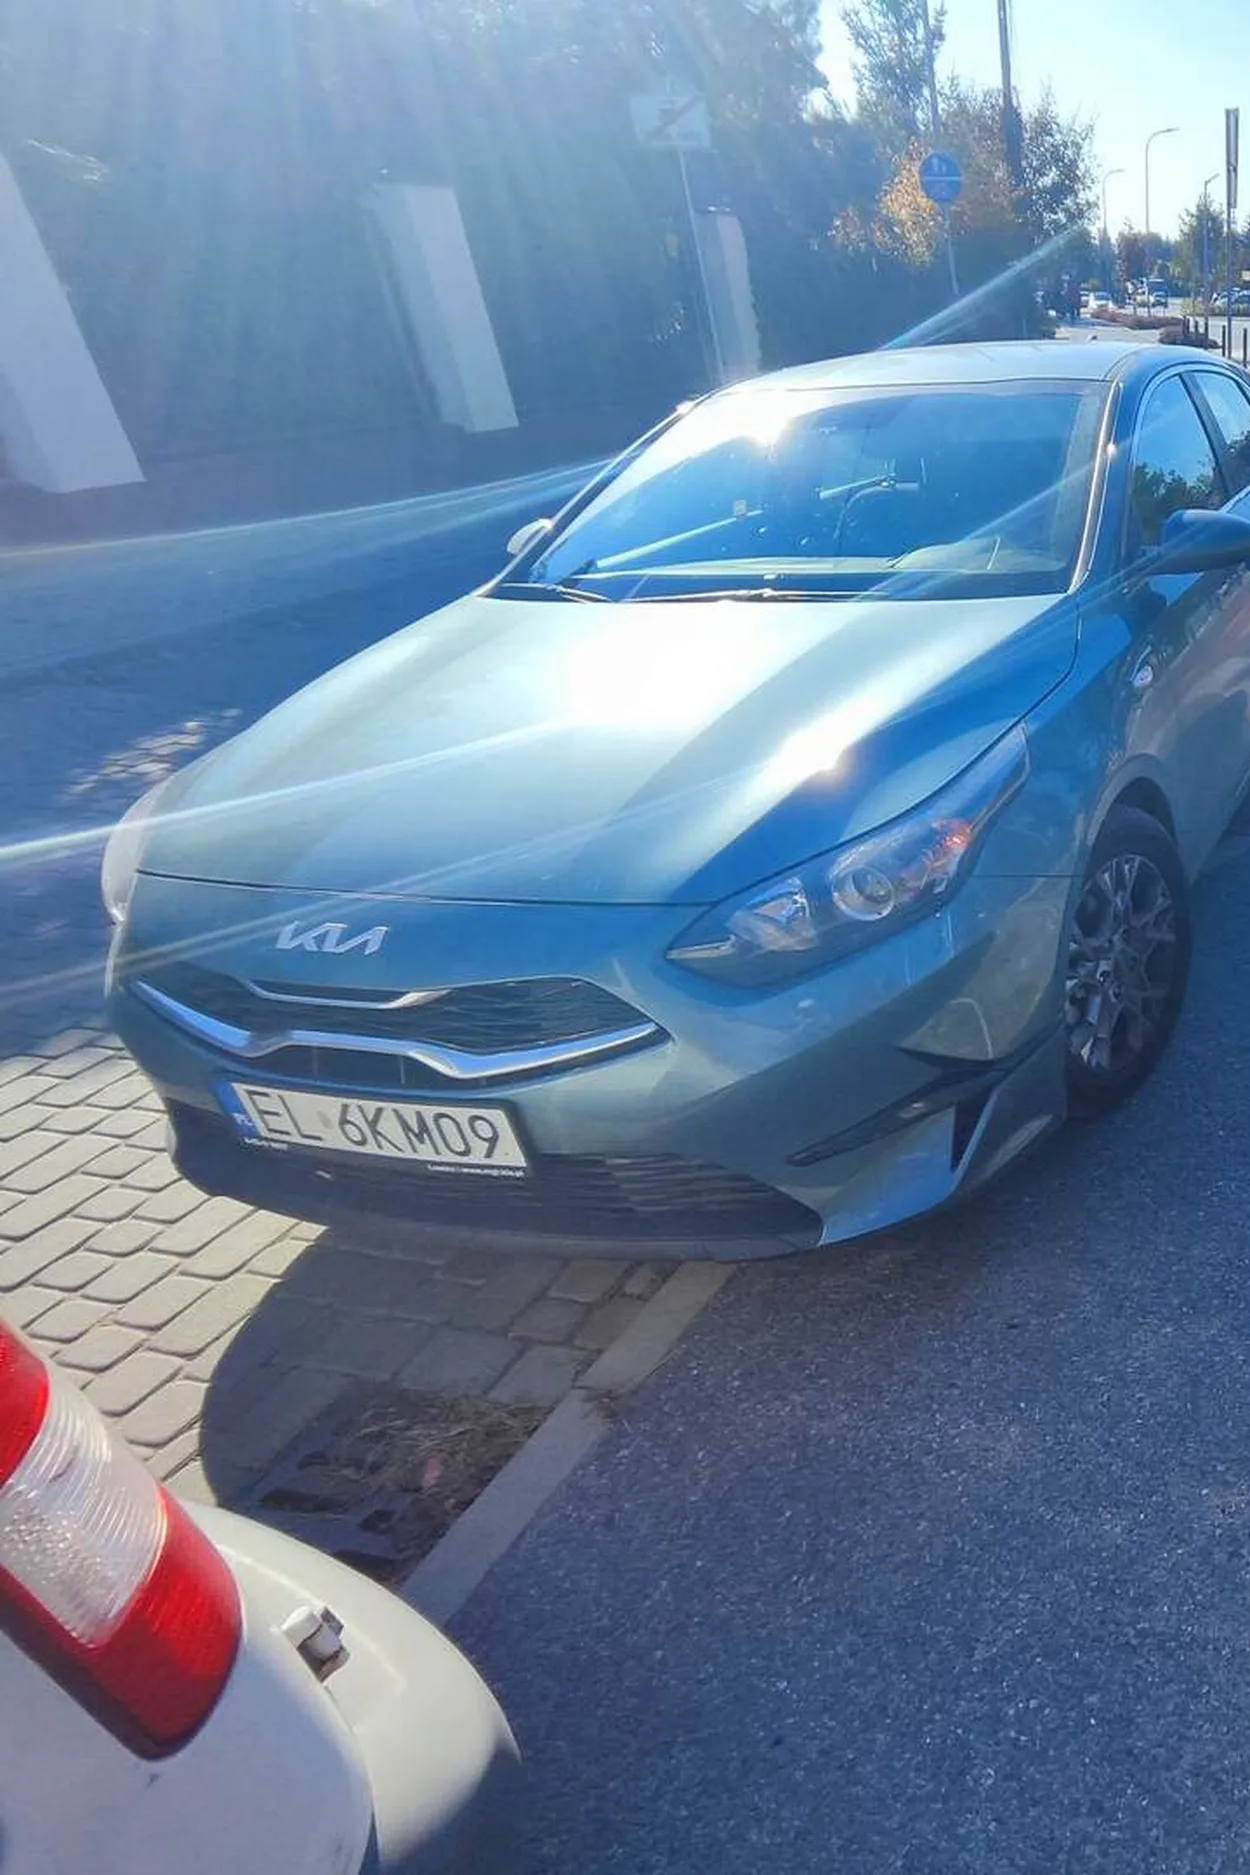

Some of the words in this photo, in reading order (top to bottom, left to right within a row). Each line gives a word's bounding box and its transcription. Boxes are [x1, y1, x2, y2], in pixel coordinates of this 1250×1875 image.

[276, 921, 389, 955] KIA
[243, 1088, 324, 1142] EL
[338, 1103, 499, 1159] 6KM09
